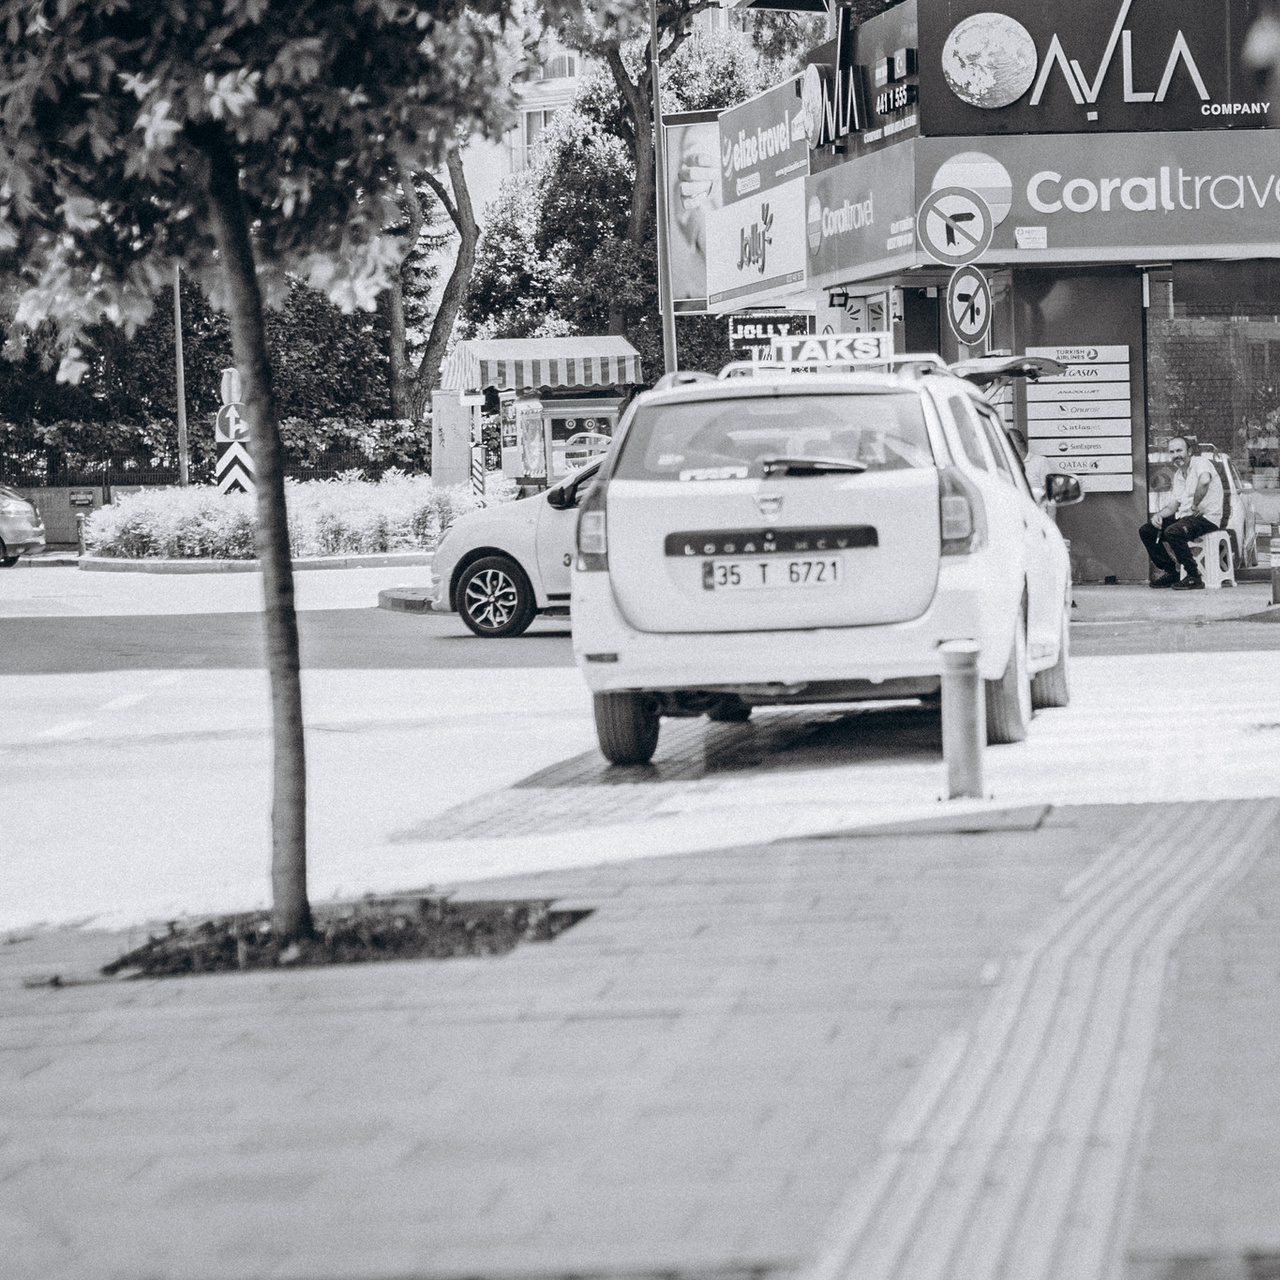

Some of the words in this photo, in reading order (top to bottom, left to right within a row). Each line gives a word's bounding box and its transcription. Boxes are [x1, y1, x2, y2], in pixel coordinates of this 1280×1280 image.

[1201, 101, 1271, 116] COMPANY
[731, 323, 791, 339] JOLLY
[1058, 461, 1088, 470] QATAR
[684, 542, 777, 556] LOGAN
[717, 564, 741, 586] 35
[759, 563, 768, 584] T
[789, 561, 838, 583] 6721
